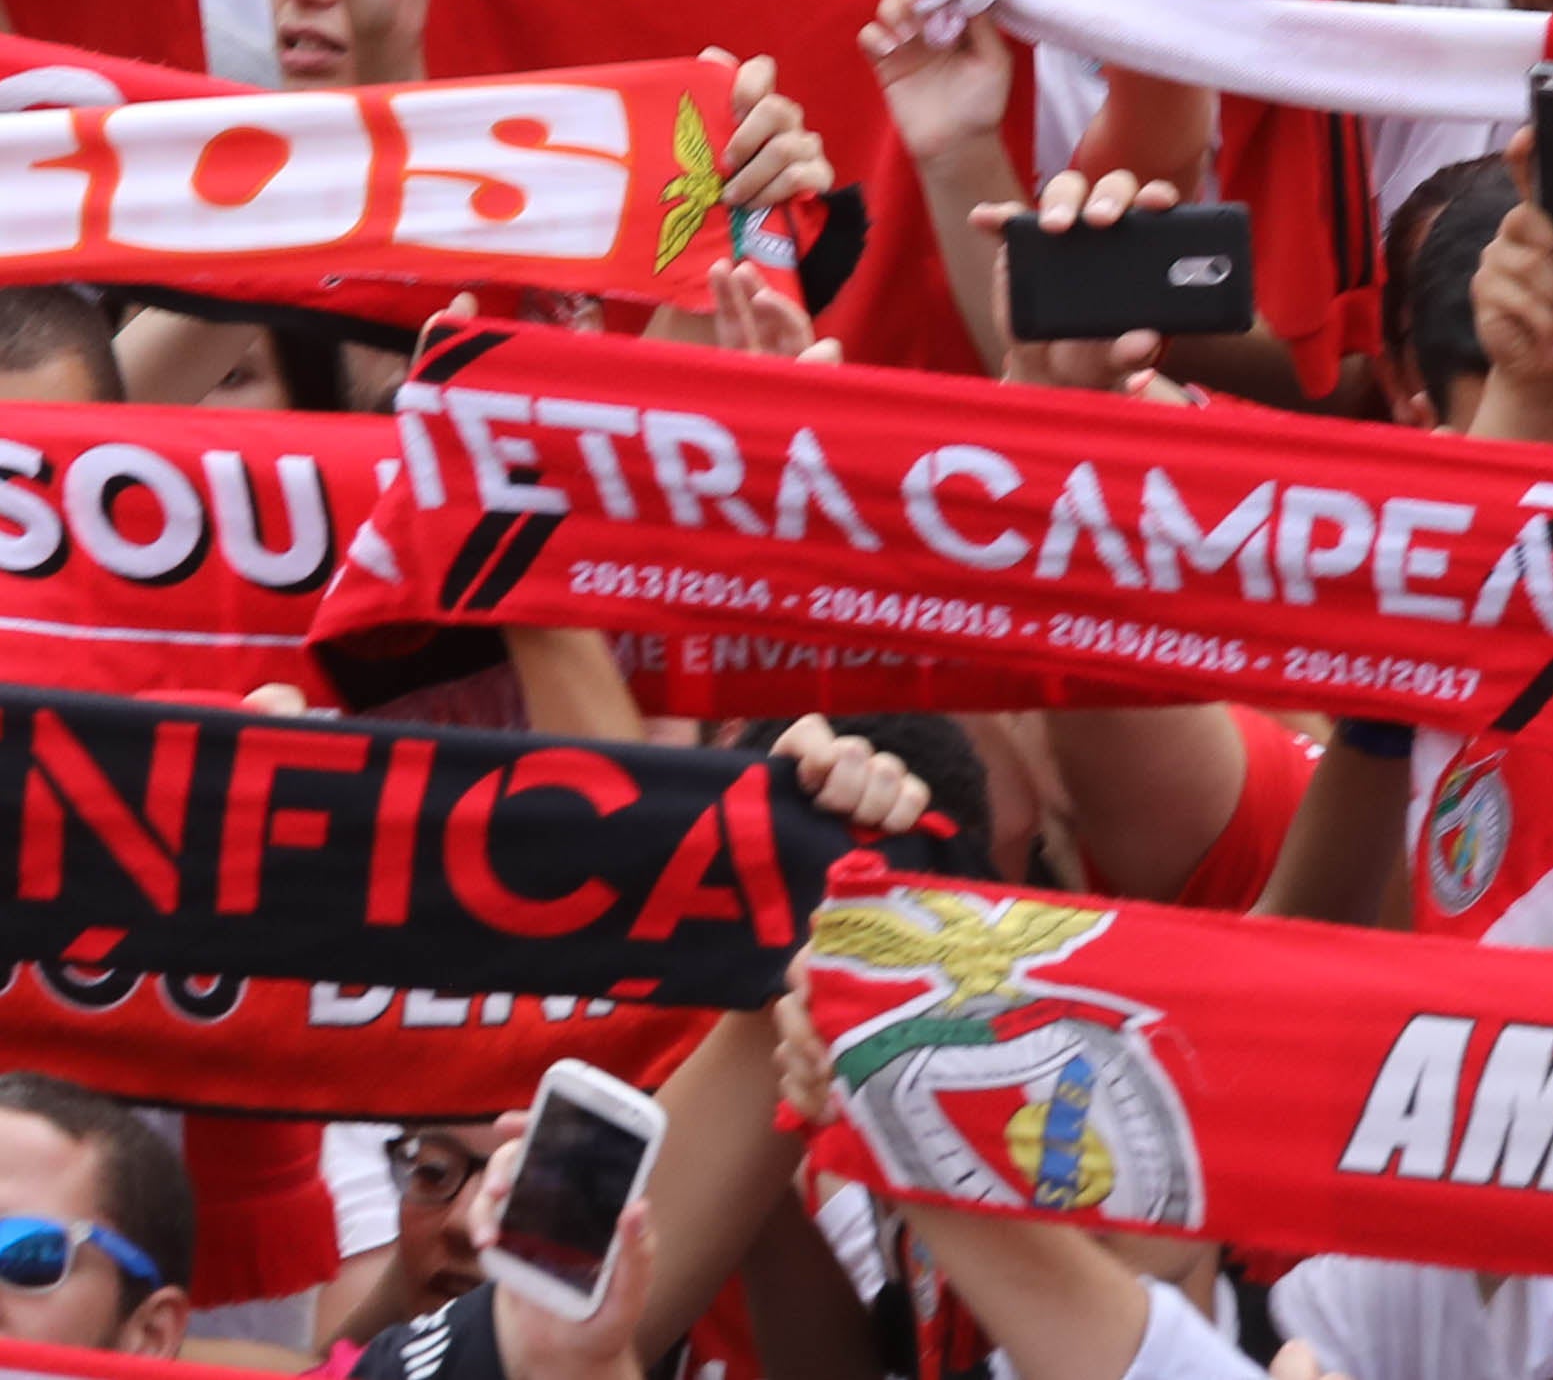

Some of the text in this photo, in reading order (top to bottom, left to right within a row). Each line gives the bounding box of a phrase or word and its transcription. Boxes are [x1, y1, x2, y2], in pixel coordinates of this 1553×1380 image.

[567, 558, 1483, 705] 2013/2014 2014/2015 2015/2016 2016/2017
